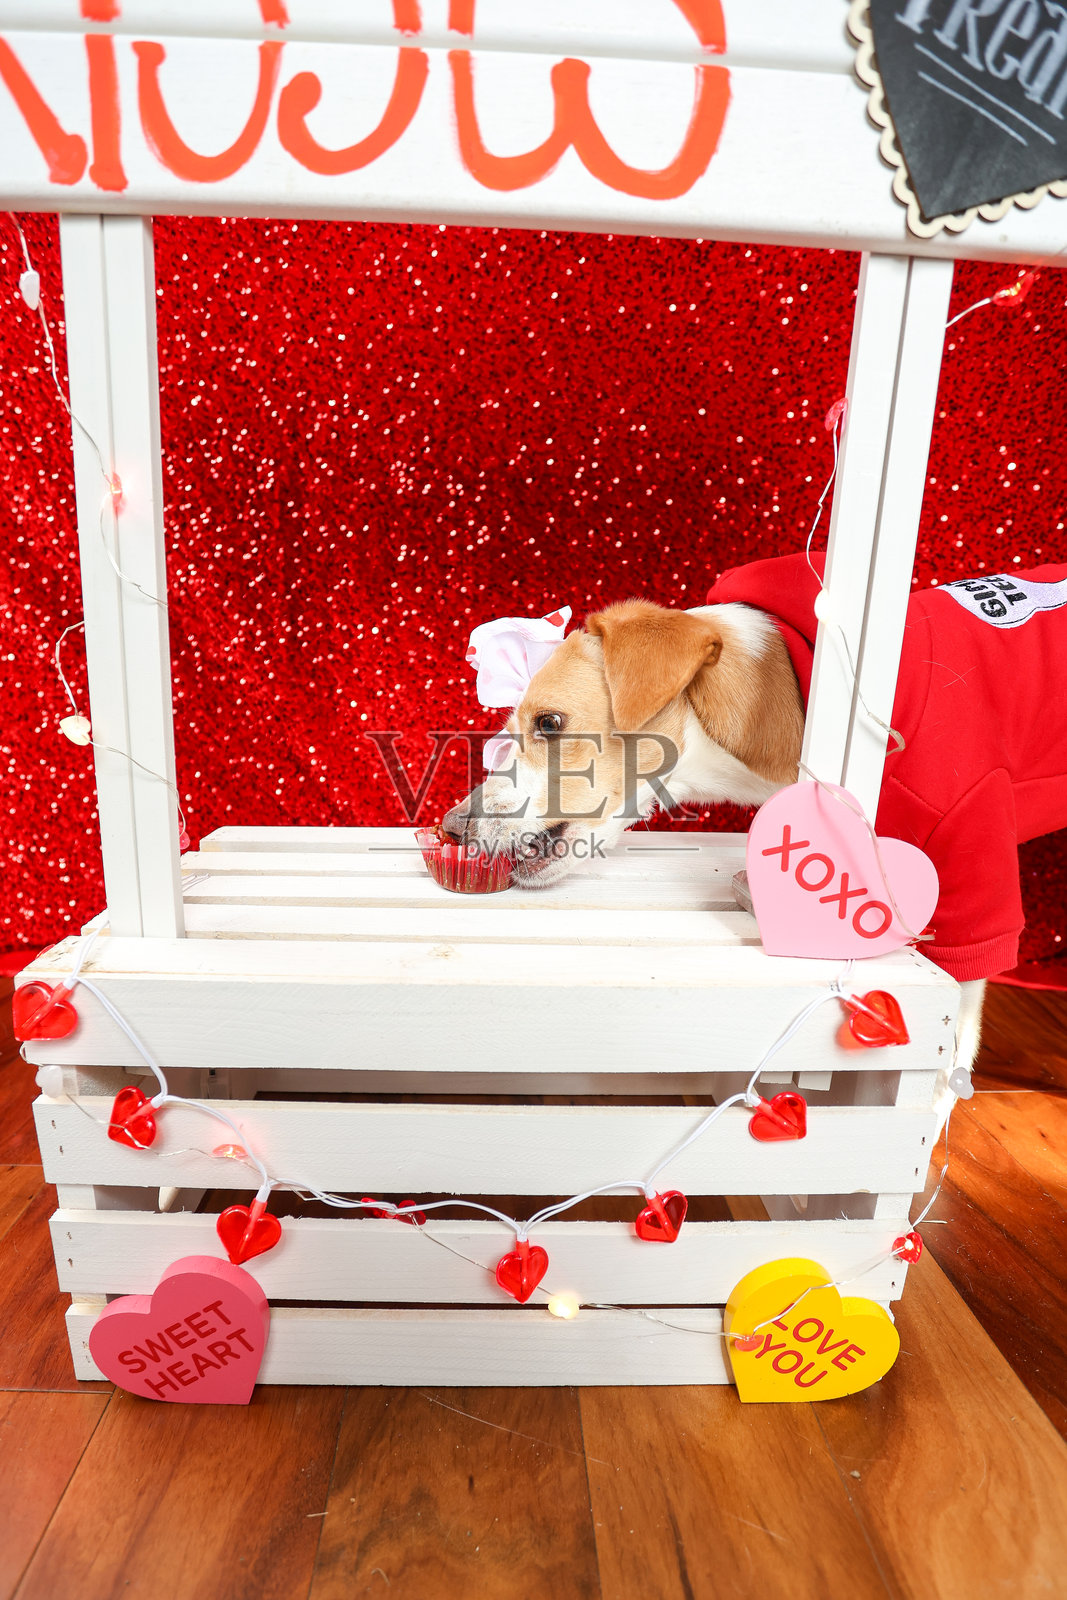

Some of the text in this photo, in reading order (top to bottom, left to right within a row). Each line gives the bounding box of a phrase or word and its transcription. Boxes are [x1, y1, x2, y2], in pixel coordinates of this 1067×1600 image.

[761, 824, 893, 939] XOXO
[117, 1300, 231, 1374] SWEET
[144, 1327, 254, 1399] HEART
[754, 1333, 828, 1388] YOU
[770, 1302, 866, 1371] LOVE
